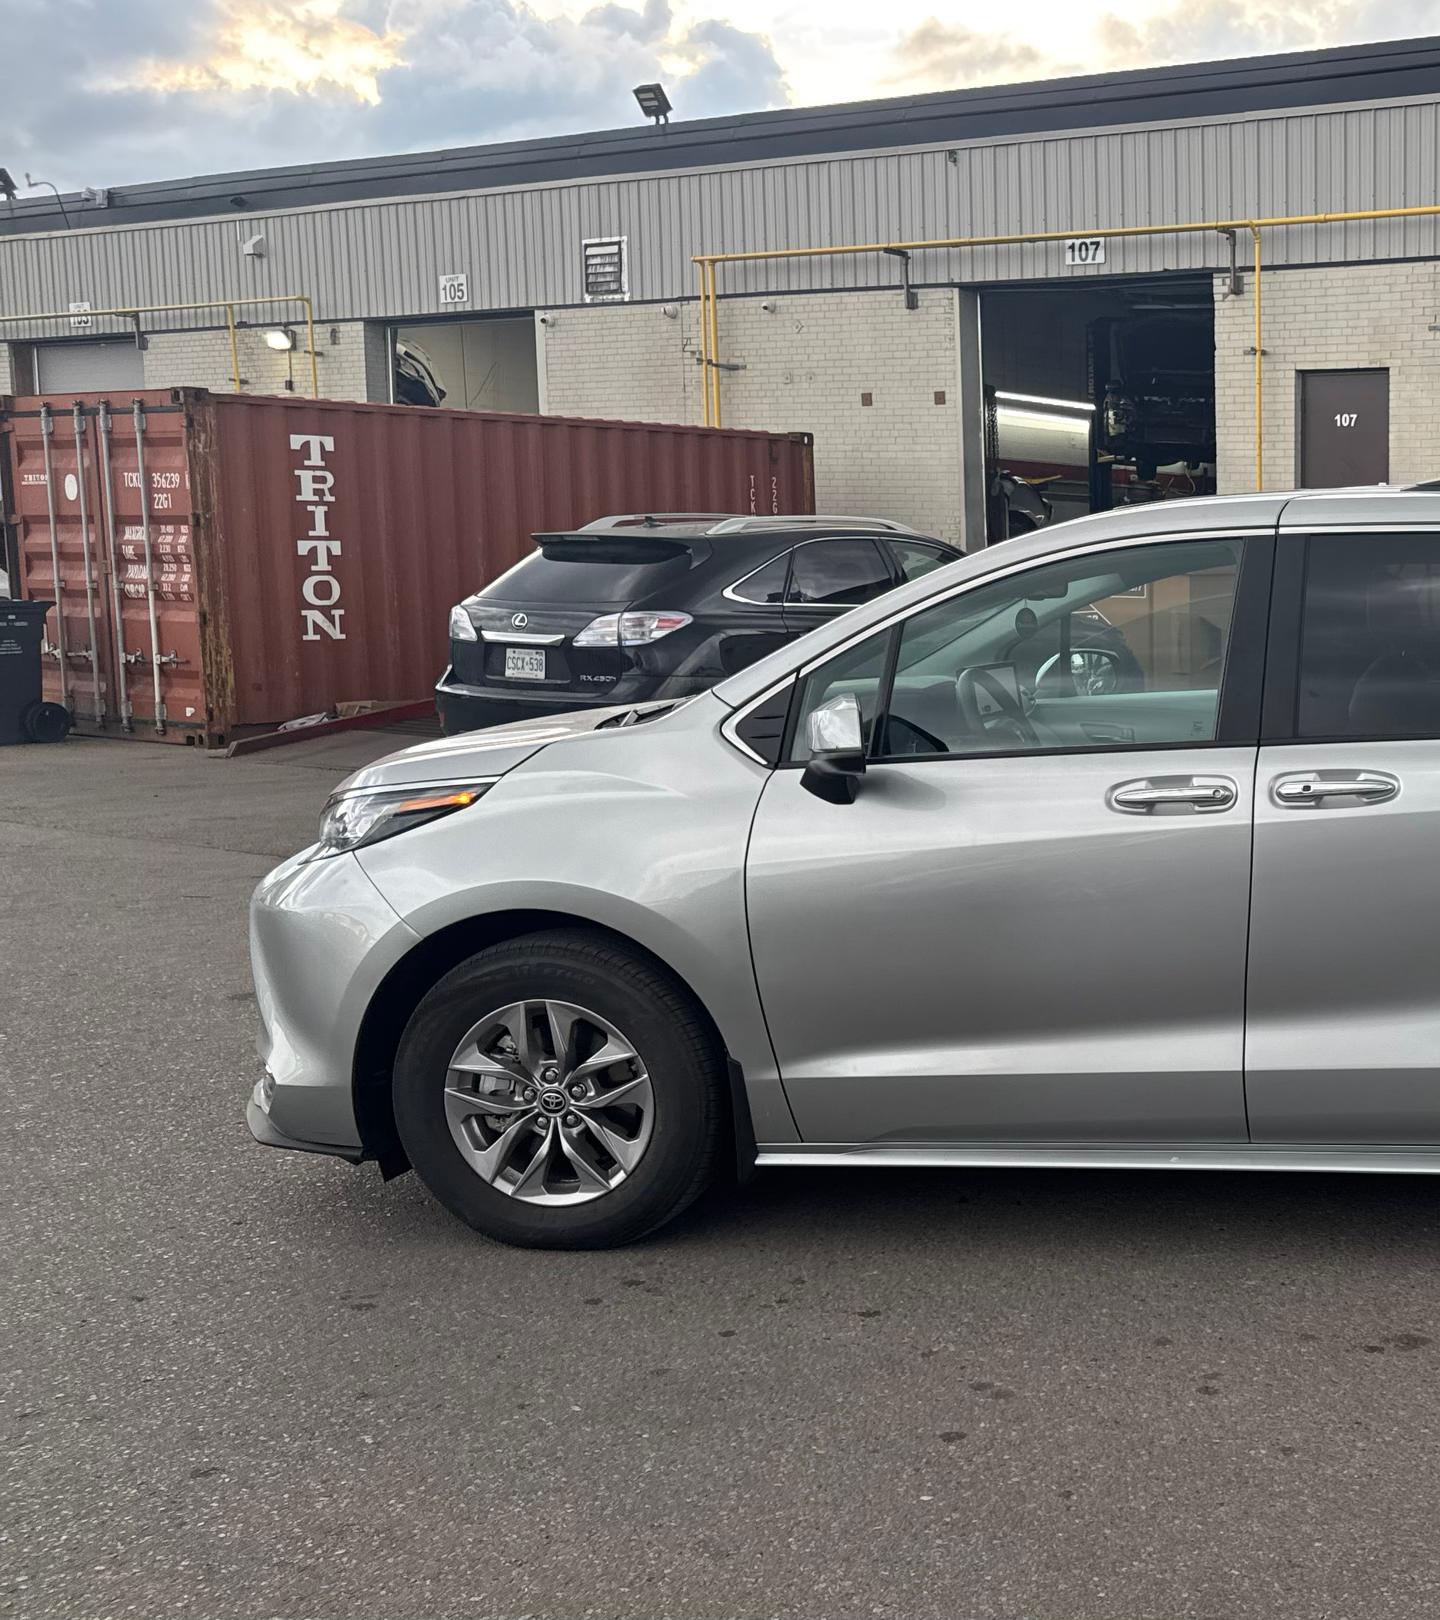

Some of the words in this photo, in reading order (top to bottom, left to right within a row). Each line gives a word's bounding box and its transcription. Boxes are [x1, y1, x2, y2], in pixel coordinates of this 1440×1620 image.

[1067, 241, 1100, 262] 107
[442, 283, 464, 301] 105
[1334, 413, 1358, 427] 107
[151, 472, 180, 489] 356239
[153, 493, 172, 509] 22G1
[291, 434, 347, 640] TRITON
[529, 657, 544, 672] 538
